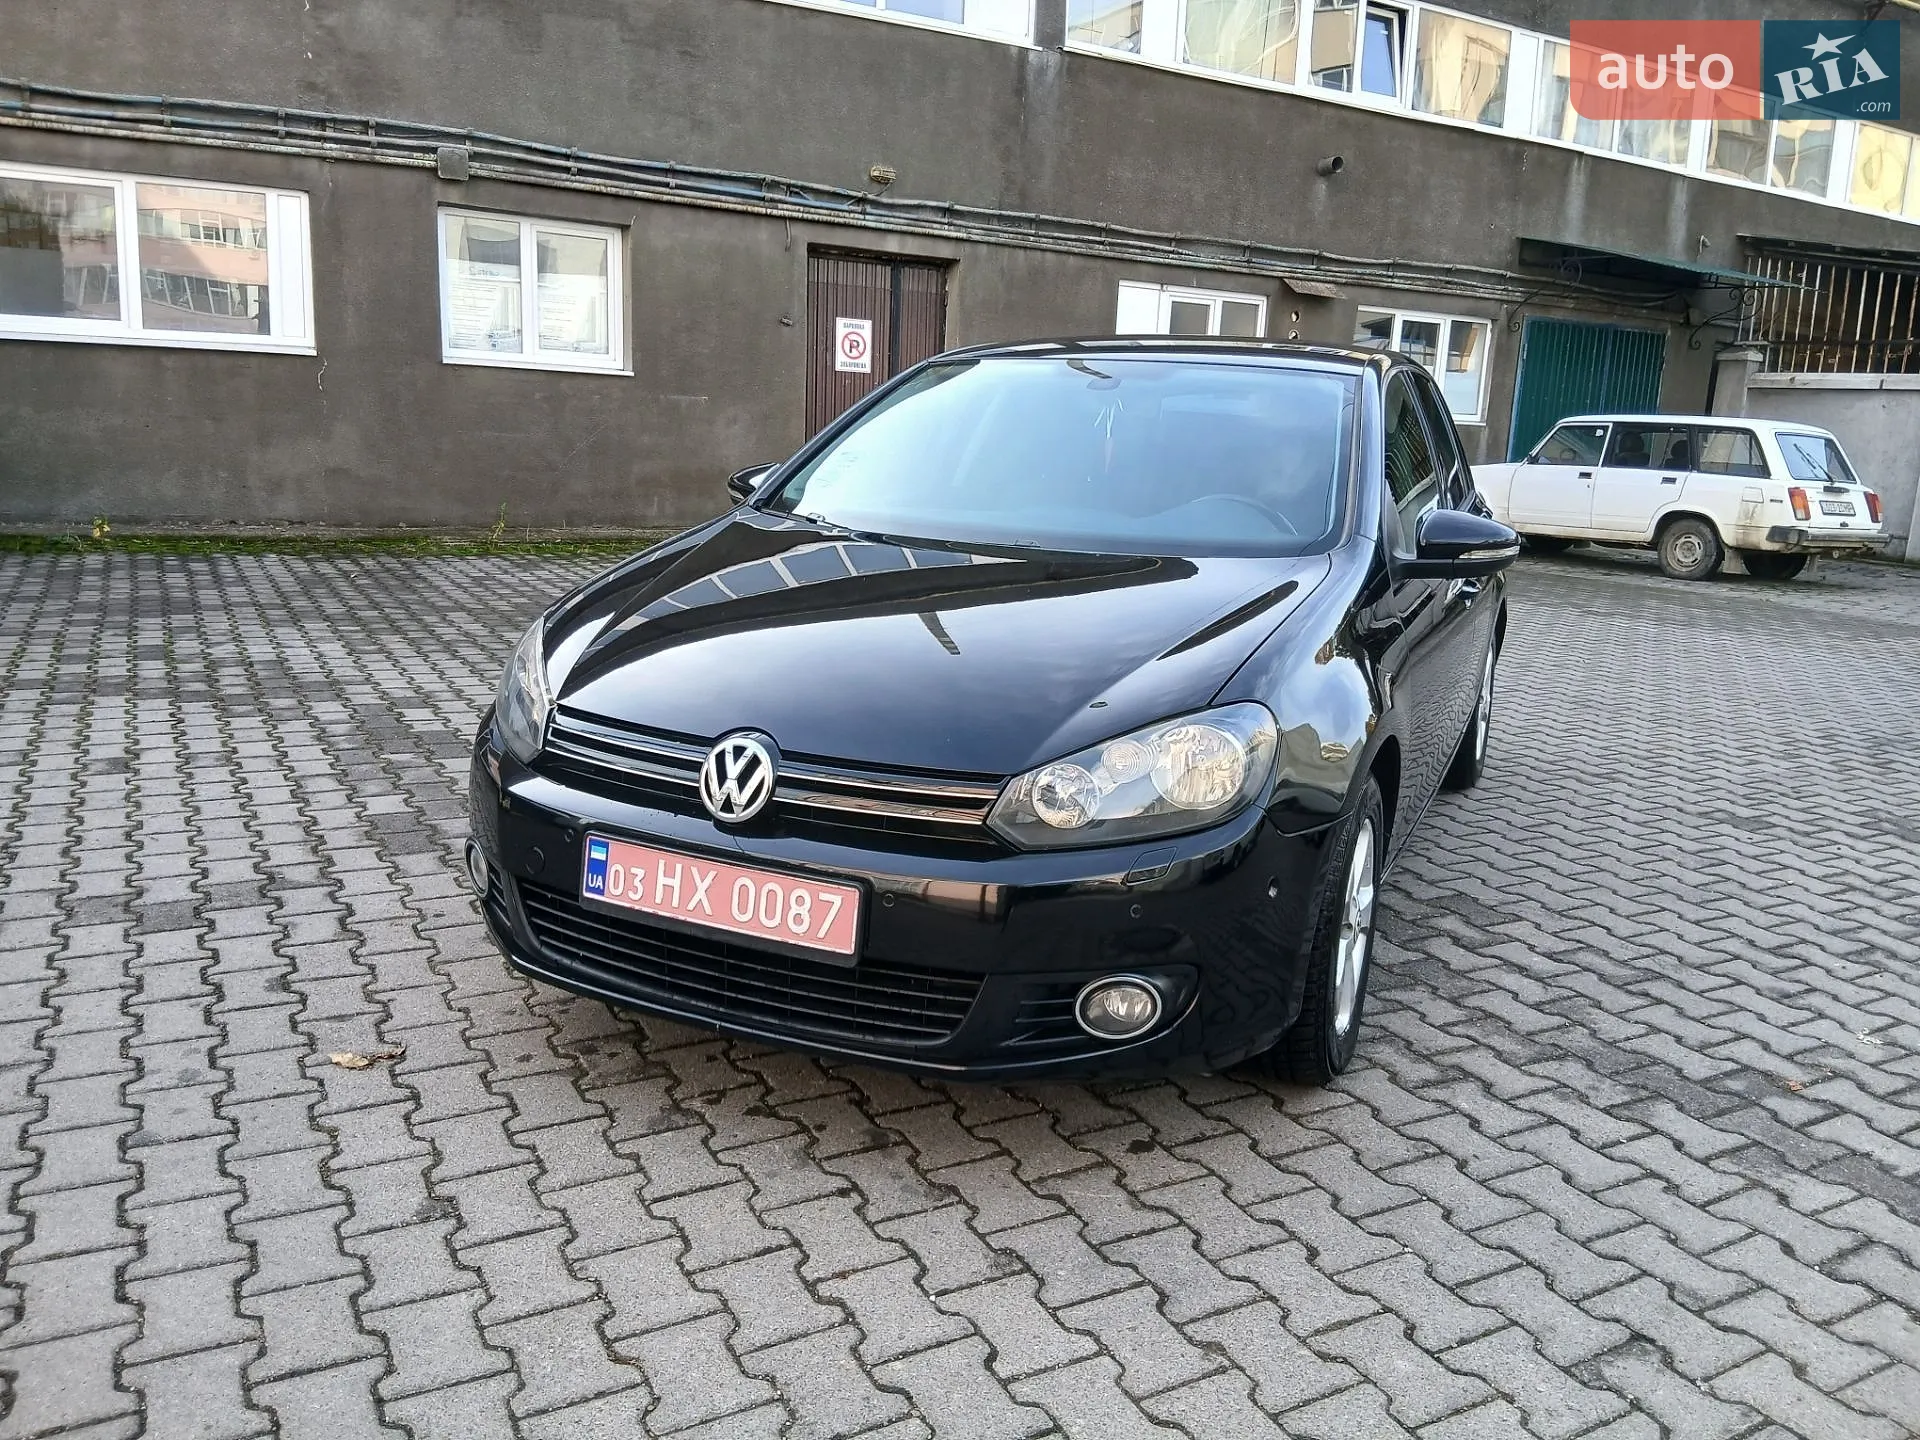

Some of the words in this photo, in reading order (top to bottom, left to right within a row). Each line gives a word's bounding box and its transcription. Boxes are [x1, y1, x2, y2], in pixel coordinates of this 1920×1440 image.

[588, 873, 604, 891] UA
[608, 863, 647, 902] 03
[654, 859, 718, 917] HX
[730, 876, 844, 940] 0087
